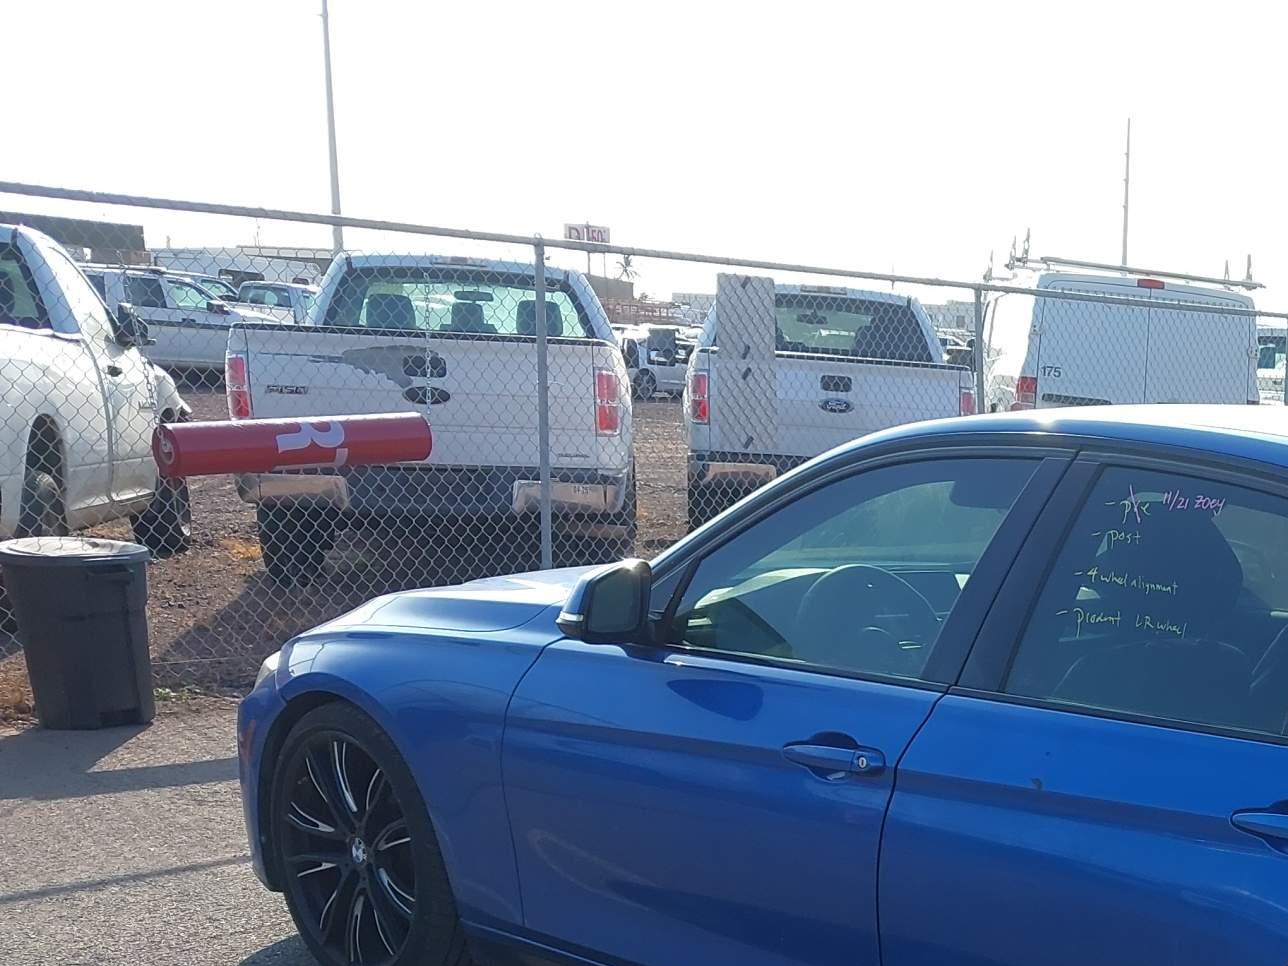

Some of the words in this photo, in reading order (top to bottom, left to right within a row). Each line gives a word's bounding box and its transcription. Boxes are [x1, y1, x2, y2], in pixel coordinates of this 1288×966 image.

[1041, 365, 1062, 378] 175
[1162, 489, 1190, 512] 11/21
[1086, 566, 1099, 583] 4
[1130, 575, 1180, 596] alignment
